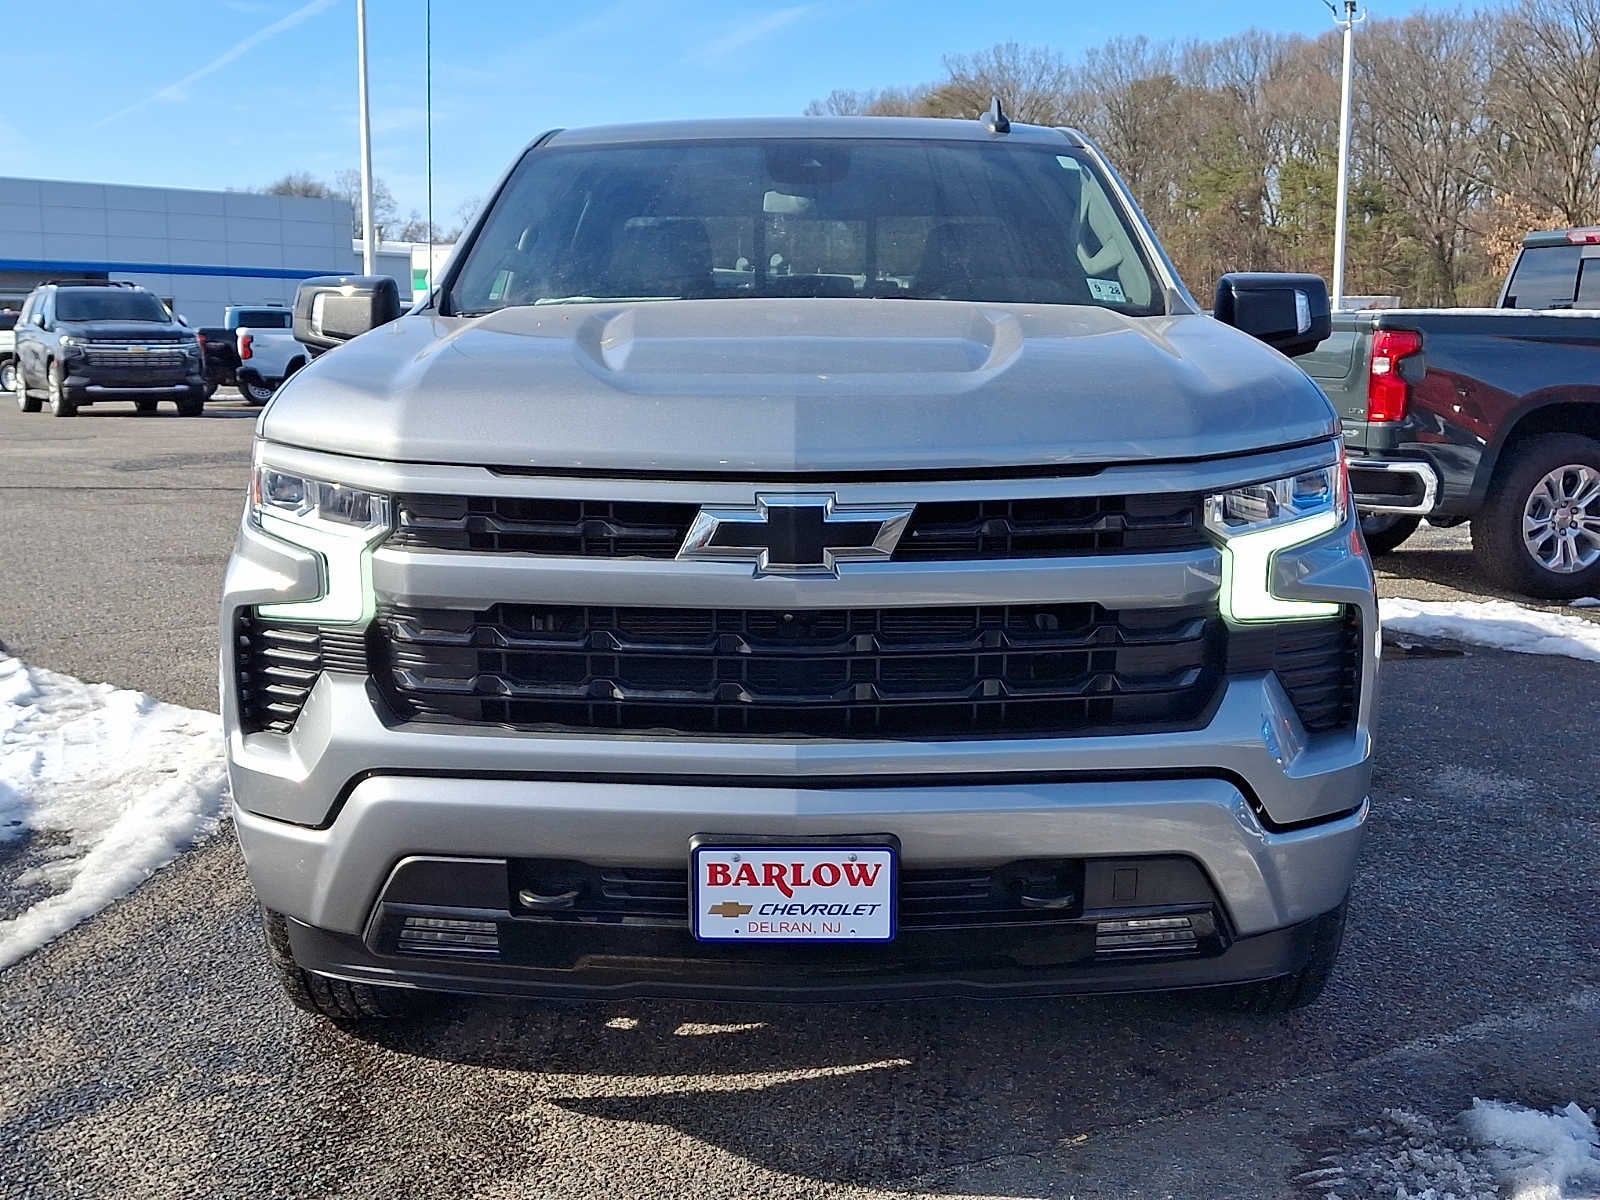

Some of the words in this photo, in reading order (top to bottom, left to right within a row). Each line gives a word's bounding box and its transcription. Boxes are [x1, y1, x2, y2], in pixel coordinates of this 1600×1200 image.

[706, 863, 882, 898] BARLOW
[758, 903, 882, 916] CHEVROLET
[748, 922, 817, 934] DELRAN,
[822, 922, 841, 933] NJ
